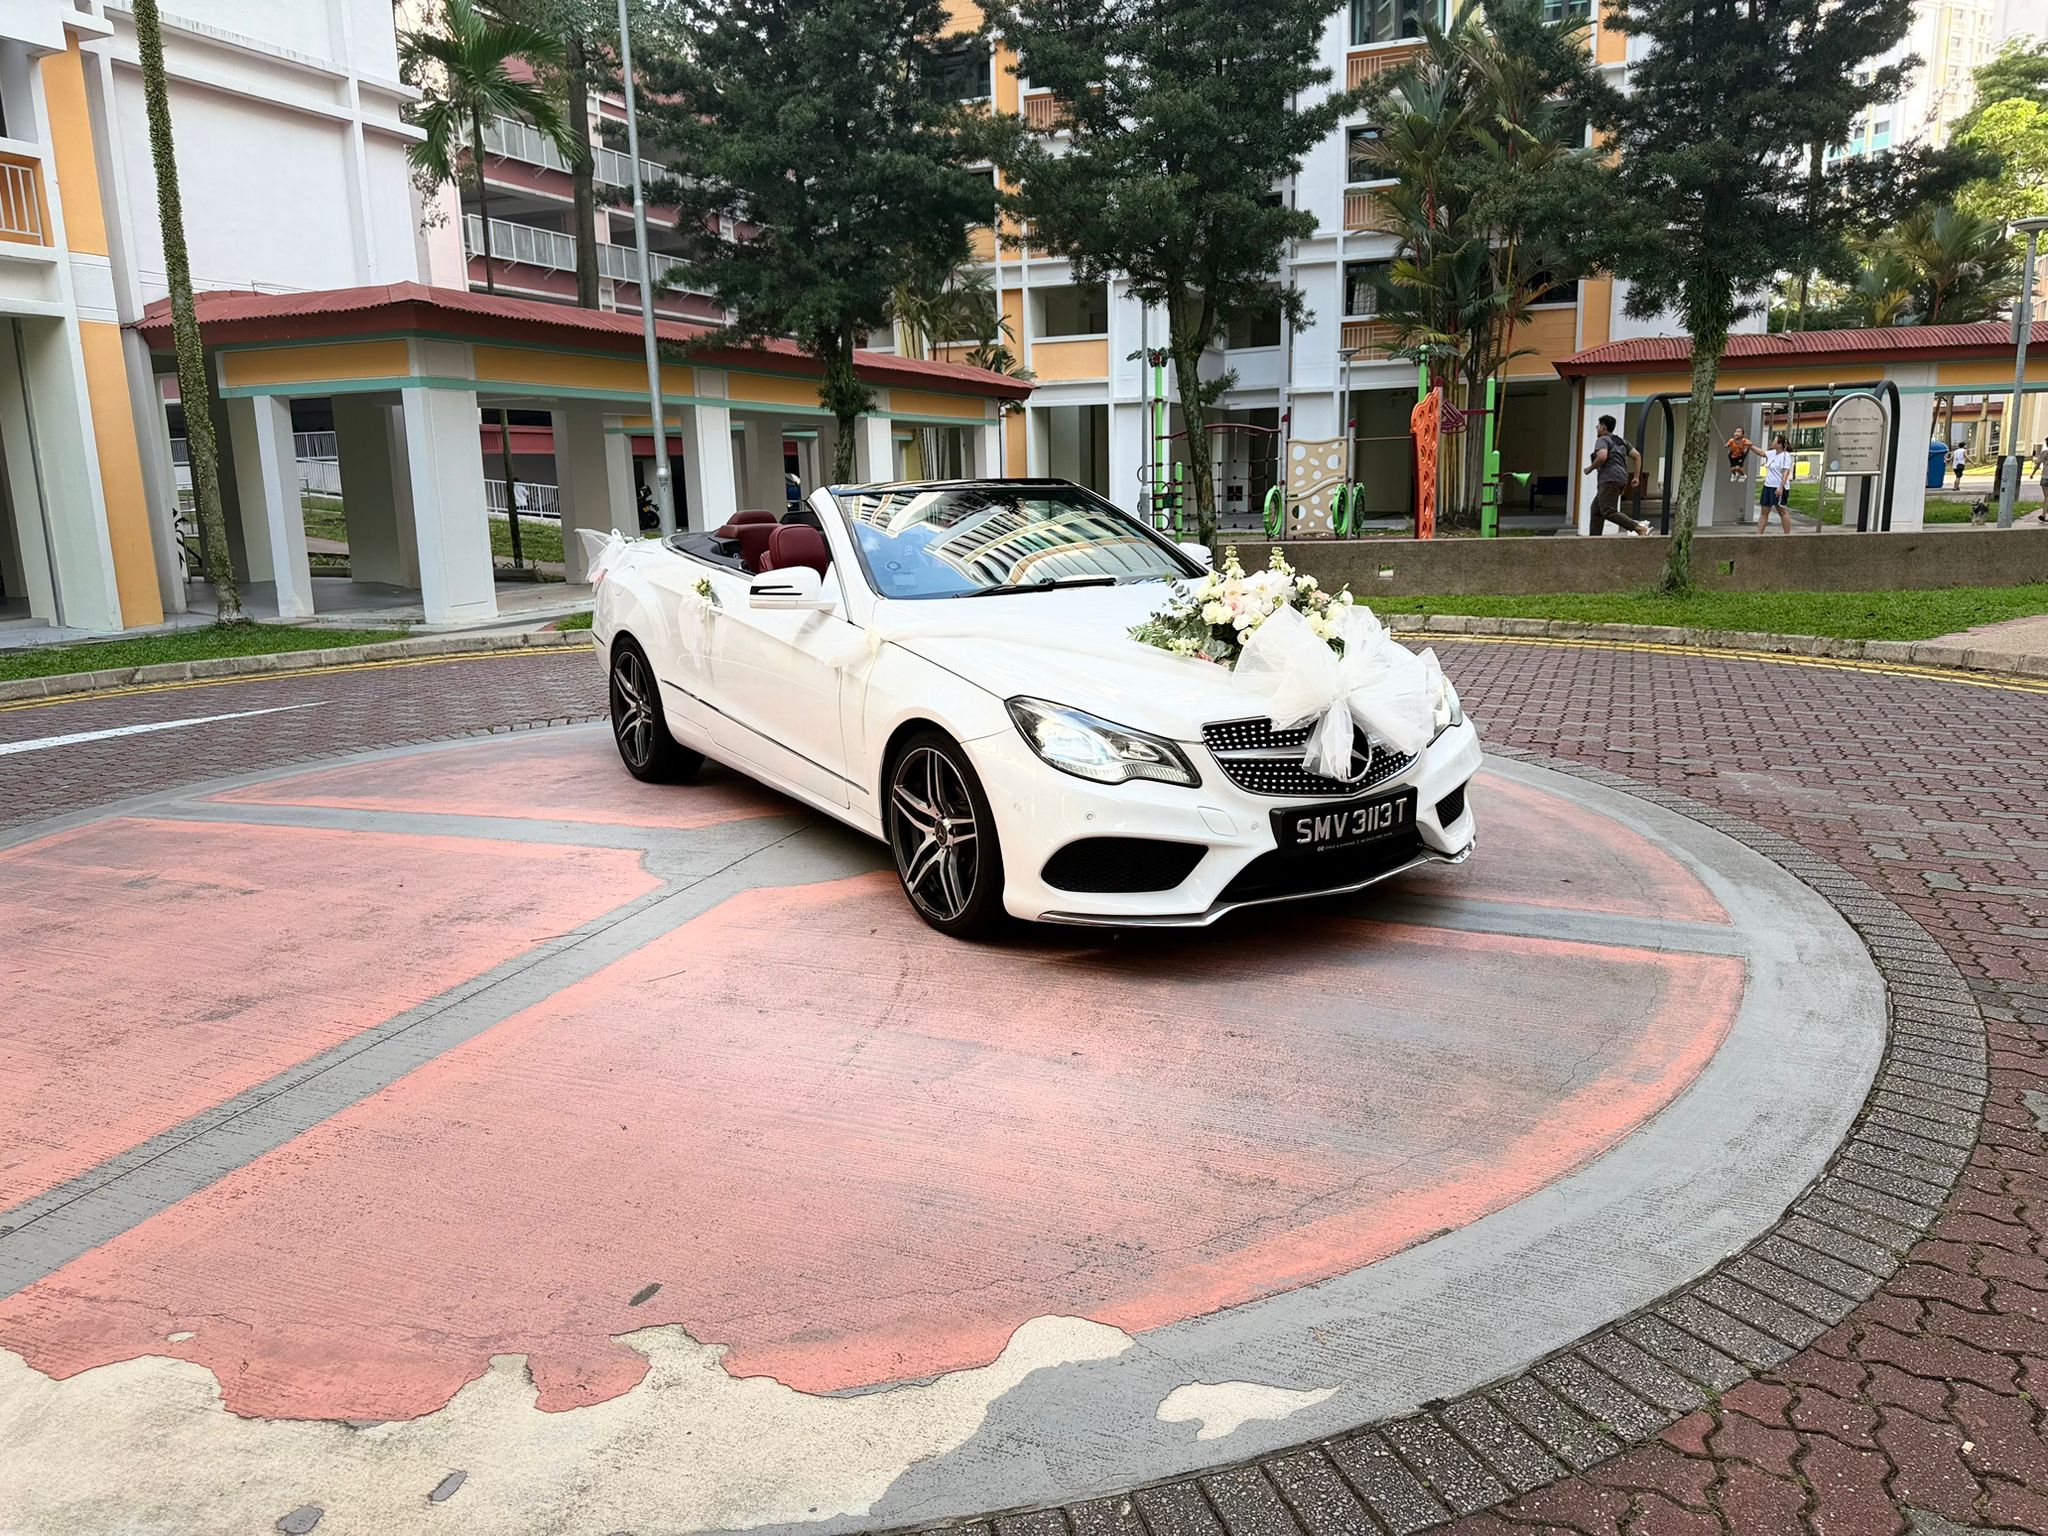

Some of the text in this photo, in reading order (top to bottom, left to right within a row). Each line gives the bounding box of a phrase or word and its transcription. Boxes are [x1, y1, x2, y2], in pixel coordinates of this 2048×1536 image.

[1296, 812, 1349, 844] SMV
[1351, 802, 1393, 835] 3113
[1395, 797, 1408, 824] T
